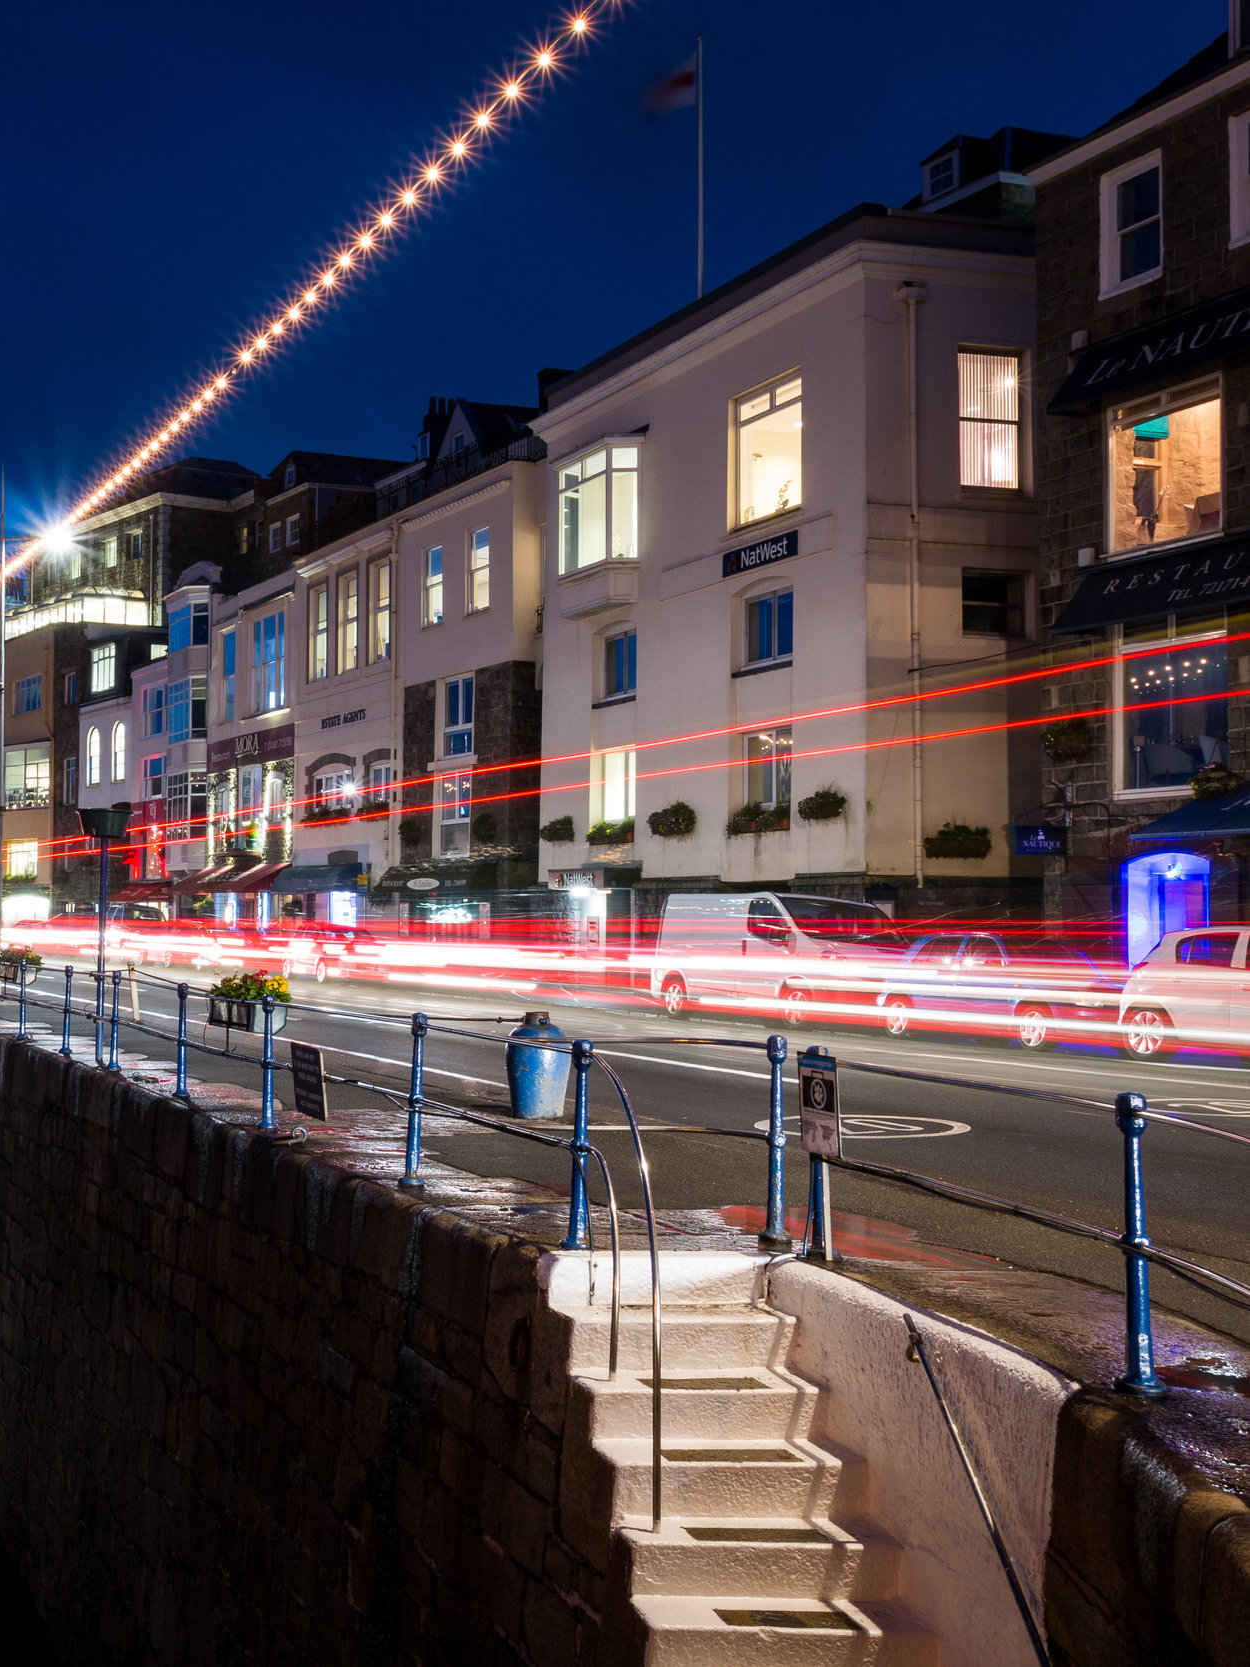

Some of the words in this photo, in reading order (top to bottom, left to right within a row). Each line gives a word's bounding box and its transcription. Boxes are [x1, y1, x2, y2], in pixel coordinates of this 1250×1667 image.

[1083, 358, 1126, 386] Le
[740, 537, 788, 569] NatWest
[1102, 552, 1250, 594] RESTAU
[321, 715, 341, 730] ESTATE
[343, 708, 366, 725] AGENTS
[235, 733, 260, 756] MORA
[1022, 839, 1062, 850] NAUTIQUE
[563, 872, 594, 887] NatWest
